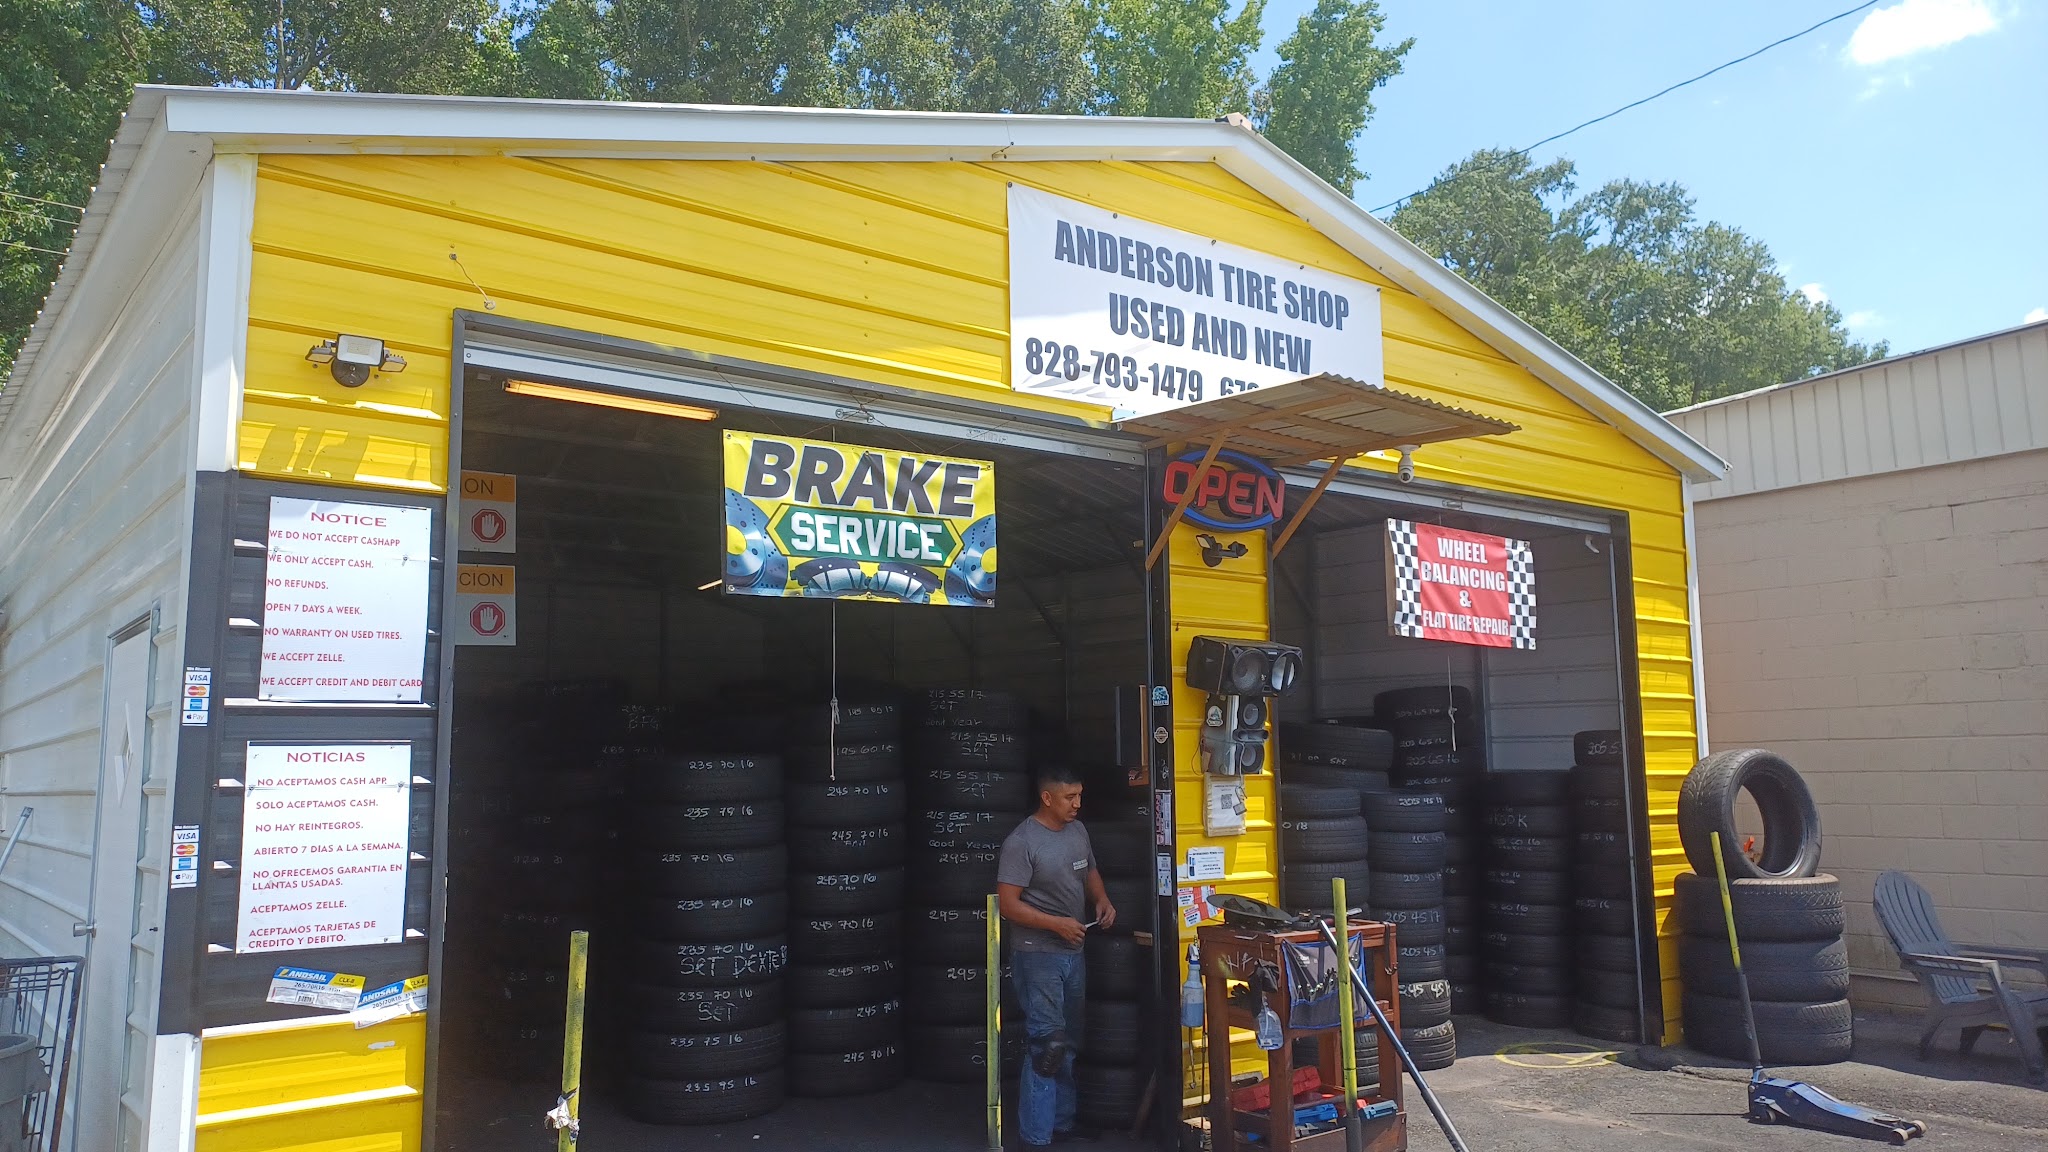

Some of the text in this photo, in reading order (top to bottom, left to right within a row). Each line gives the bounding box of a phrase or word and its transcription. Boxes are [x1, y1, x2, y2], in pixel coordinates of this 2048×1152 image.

[1055, 219, 1349, 331] ANDERSON TIRE SHOP
[1109, 292, 1311, 375] USED AND NEW
[1026, 337, 1202, 403] 828-793-1479
[742, 439, 981, 518] BRAKE
[1163, 461, 1285, 518] OPEN
[311, 512, 387, 527] NOTICE
[269, 530, 400, 547] WE DO NOT ACCEPT CASHAPP
[790, 512, 943, 560] SERVICE
[1438, 537, 1488, 563] WHEEL
[268, 554, 374, 568] WE ONLY ACCEPT CASH.
[1421, 561, 1505, 592] BALANCING
[267, 579, 329, 589] NO REFUNDS.
[1459, 590, 1472, 608] &
[266, 603, 290, 612] OPEN
[302, 605, 325, 613] DAYS
[327, 605, 333, 613] A
[336, 606, 362, 614] WEEK.
[1422, 610, 1509, 636] FLAT TIRE REPAIR
[281, 628, 332, 637] WARRANTY
[335, 630, 348, 638] ON
[351, 631, 374, 639] USED
[377, 632, 402, 640] TIRES.
[263, 653, 345, 662] WE ACCEPT ZELLE.
[262, 677, 275, 685] WE
[278, 678, 313, 686] ACCEPT
[316, 678, 348, 686] CREDIT
[372, 679, 397, 687] DEBIT
[400, 679, 423, 687] CARD
[287, 752, 365, 762] NOTICIAS
[689, 761, 713, 770] 235
[741, 760, 753, 769] 16
[277, 778, 337, 786] ACEPTAMOS
[340, 777, 366, 785] CASH
[369, 777, 387, 785] APP.
[827, 787, 848, 796] 245
[877, 785, 888, 794] 16
[256, 799, 378, 809] SOLO ACEPTAMOS CASH.
[684, 806, 753, 818] 235 16
[255, 824, 272, 832] NO
[299, 822, 363, 830] REINTEGROS.
[832, 829, 889, 840] 245 70 16
[254, 846, 299, 855] ABIERTO
[312, 845, 333, 853] DIAS
[346, 844, 358, 852] LA
[361, 843, 403, 851] SEMANA.
[662, 854, 709, 862] 235 70
[254, 870, 270, 878] NO
[273, 867, 334, 878] OFRECEMOS
[337, 865, 387, 874] GARANTIA
[253, 879, 343, 890] LLANTAS USADAS.
[816, 874, 859, 885] 245 70
[251, 901, 346, 913] ACEPTAMOS ZELLE.
[678, 898, 753, 910] 235 70 16
[249, 921, 376, 936] ACEPTAMOS TARJETAS DE
[811, 919, 874, 930] 245 70 16
[249, 938, 294, 948] CREDITO
[307, 935, 345, 944] DEBITO.
[712, 945, 733, 954] 70
[740, 943, 754, 953] 16
[278, 969, 327, 982] LANDSAIL
[828, 961, 893, 977] 245 70 16
[359, 985, 399, 1004] ANDSAIL
[678, 992, 704, 1001] 235
[714, 990, 730, 1000] 70
[856, 1003, 891, 1018] 245 70
[671, 1037, 695, 1047] 235
[729, 1034, 743, 1044] 16
[844, 1047, 895, 1063] 245 70 16
[685, 1077, 757, 1092] 235 16
